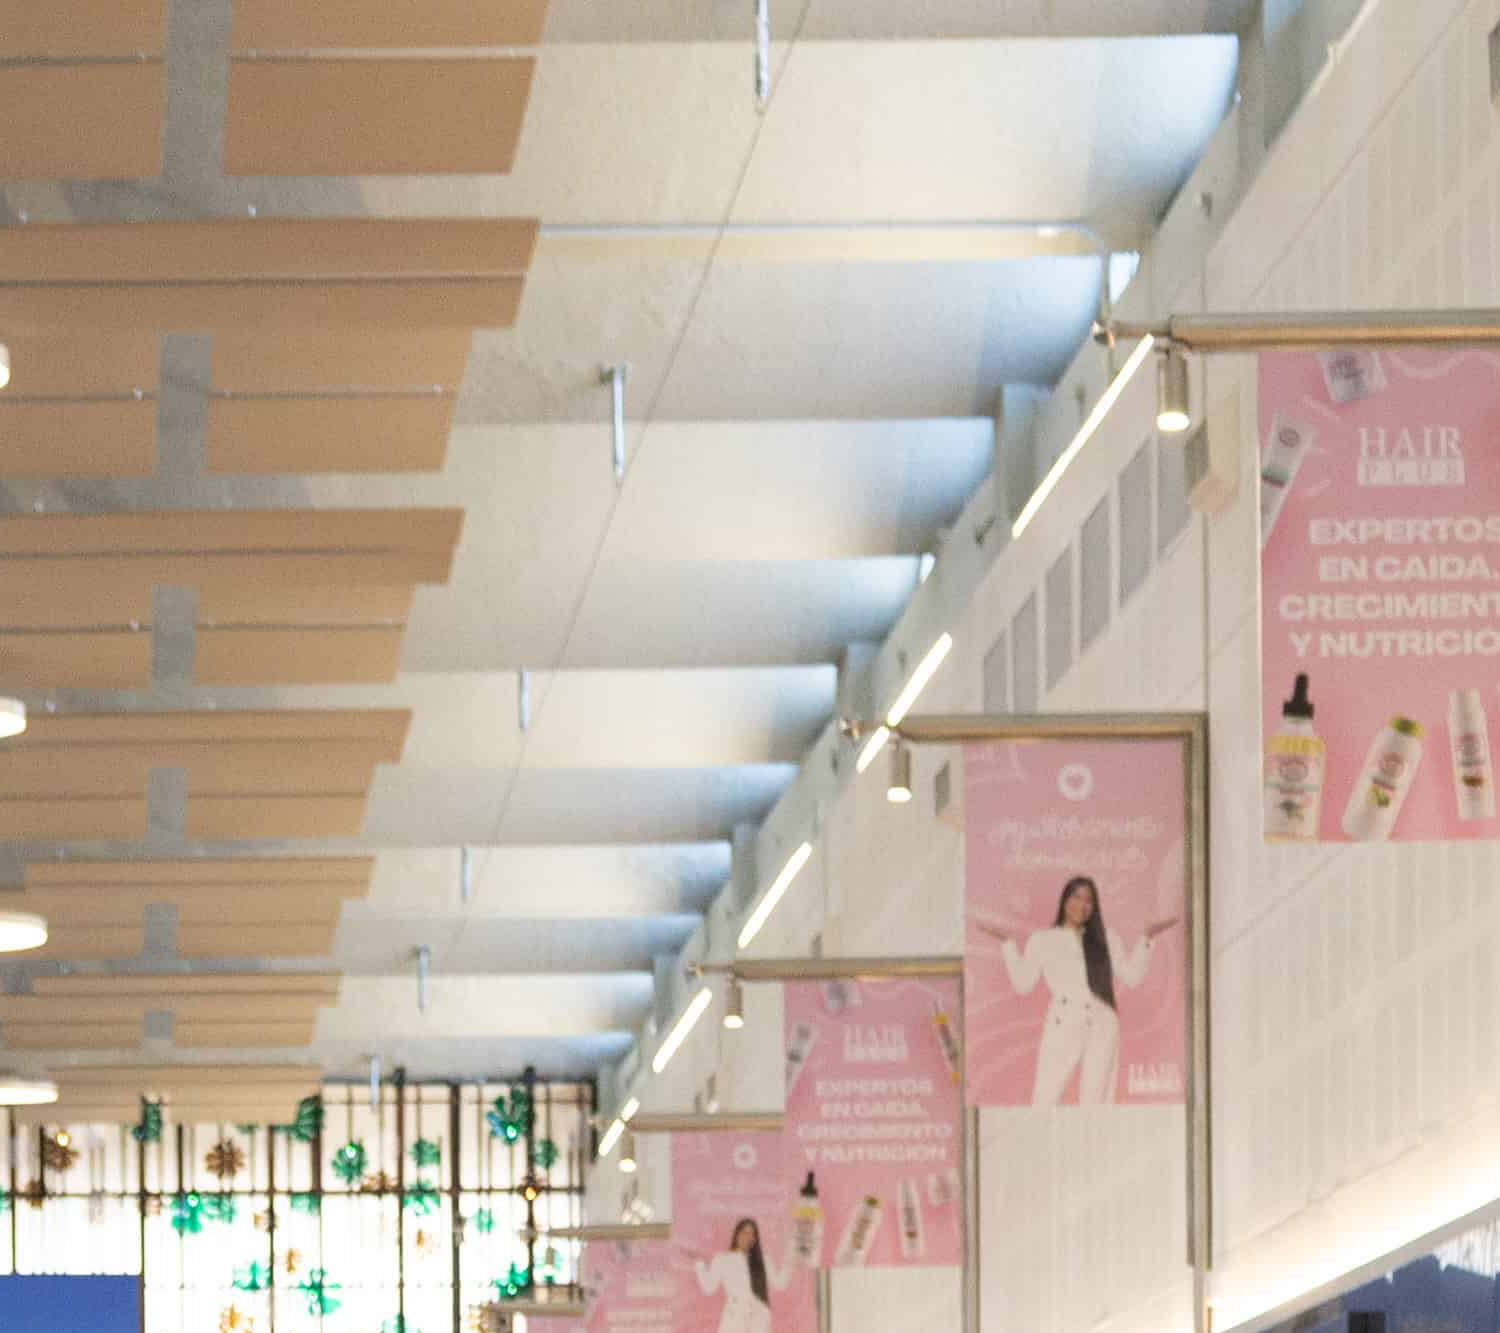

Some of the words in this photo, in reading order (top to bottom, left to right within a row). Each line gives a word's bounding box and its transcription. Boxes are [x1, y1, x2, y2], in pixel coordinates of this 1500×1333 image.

[1357, 426, 1463, 457] HAIR
[1319, 556, 1368, 582] EN
[1288, 631, 1312, 657] Y
[816, 1080, 934, 1096] EXPERTOS
[821, 1103, 850, 1118] EN
[797, 1122, 952, 1139] CRECIMIENTO
